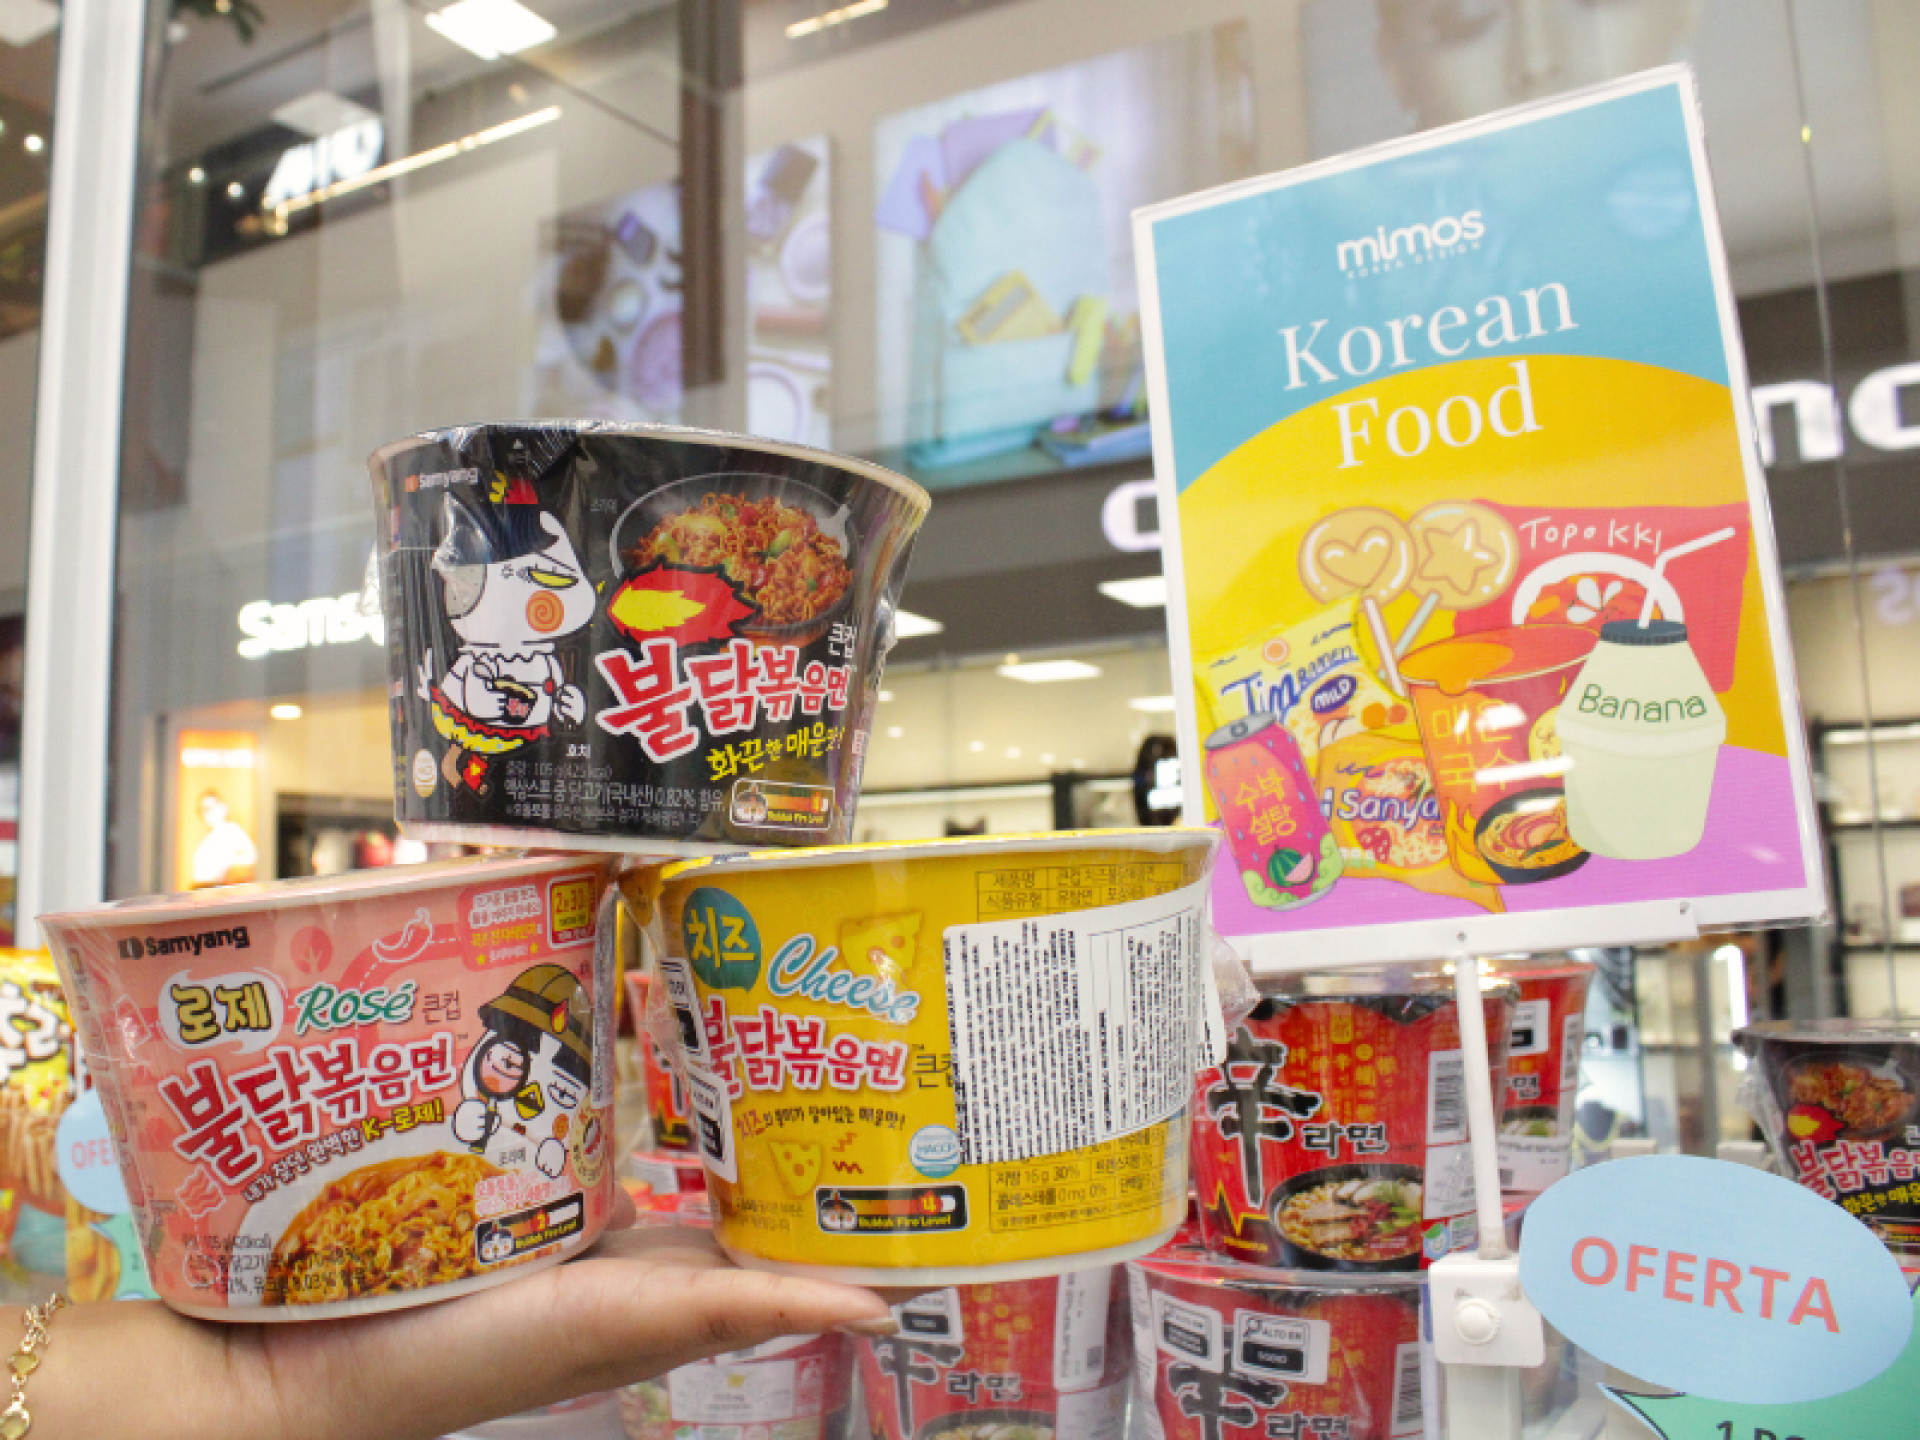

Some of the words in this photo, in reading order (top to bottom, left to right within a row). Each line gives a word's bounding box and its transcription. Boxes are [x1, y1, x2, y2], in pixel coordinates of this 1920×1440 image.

[1337, 210, 1485, 271] mimos
[1277, 280, 1579, 391] Korean
[1333, 359, 1543, 469] Food
[594, 637, 850, 764] 불닭볶음면
[1578, 683, 1708, 723] Banana
[146, 926, 250, 956] Samyang
[686, 906, 755, 968] 치즈
[422, 990, 462, 1024] 큰컵
[767, 933, 921, 1024] Cheese
[170, 981, 272, 1044] 로제
[158, 1032, 456, 1184] 불닭볶음면
[71, 1138, 118, 1170] OFE
[1300, 1120, 1390, 1159] 라면
[1570, 1235, 1842, 1334] OFERTA
